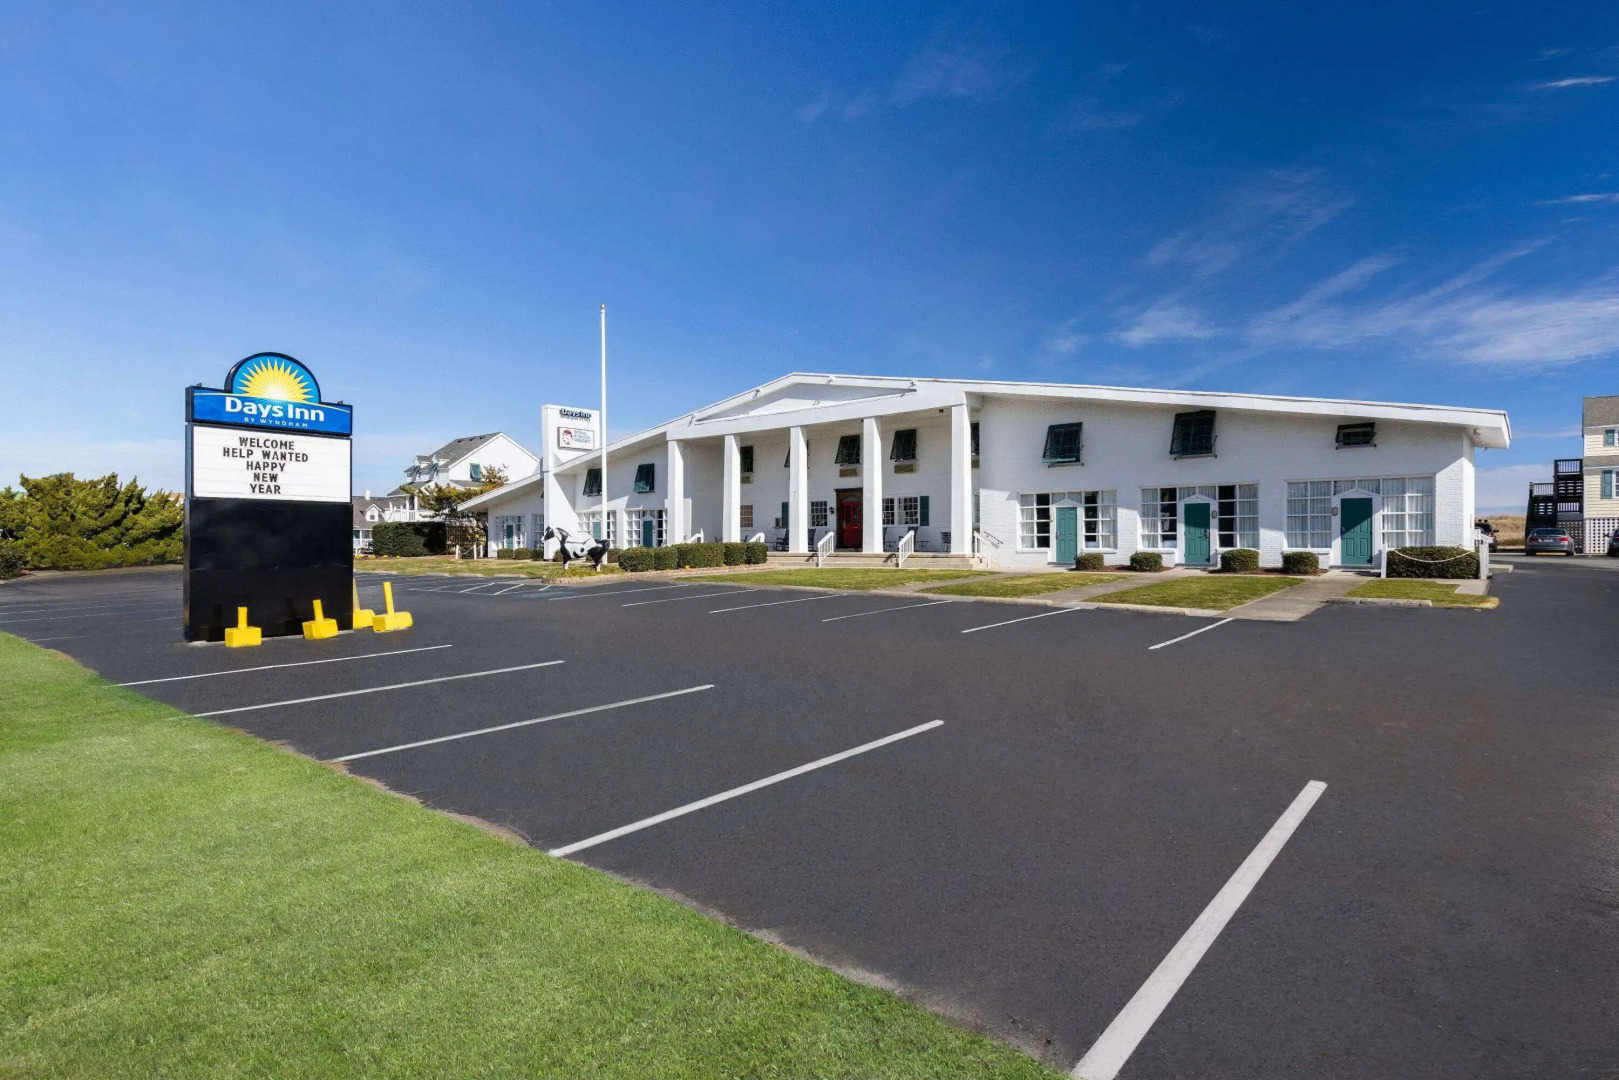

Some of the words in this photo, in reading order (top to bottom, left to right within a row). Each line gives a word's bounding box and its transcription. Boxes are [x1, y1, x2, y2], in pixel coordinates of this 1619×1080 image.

[225, 396, 284, 418] Days
[287, 403, 325, 422] Inn
[260, 418, 308, 428] WYNDHAM
[239, 437, 295, 450] WELCOME
[222, 447, 254, 459] HELP
[262, 450, 309, 462] WANTED
[246, 461, 286, 472] HAPPY
[253, 472, 278, 483] NEW
[250, 483, 281, 494] YEAR
